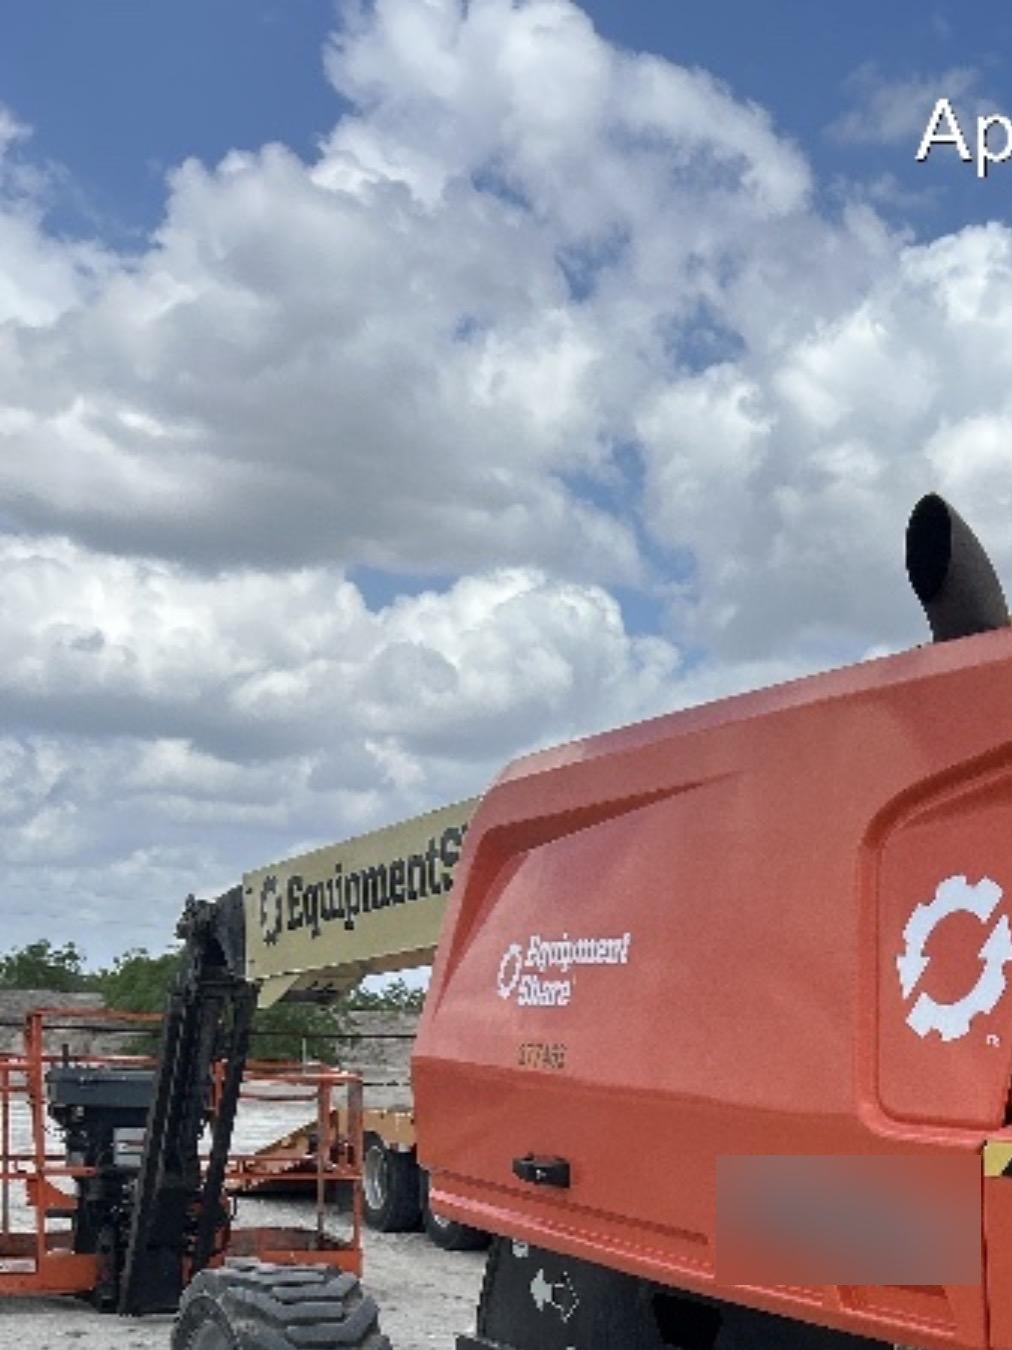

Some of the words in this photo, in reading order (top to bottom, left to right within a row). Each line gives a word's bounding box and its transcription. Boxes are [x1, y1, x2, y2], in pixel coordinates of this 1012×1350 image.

[287, 822, 468, 940] EquipmentS
[525, 933, 631, 972] Equipment
[518, 974, 571, 1006] Share
